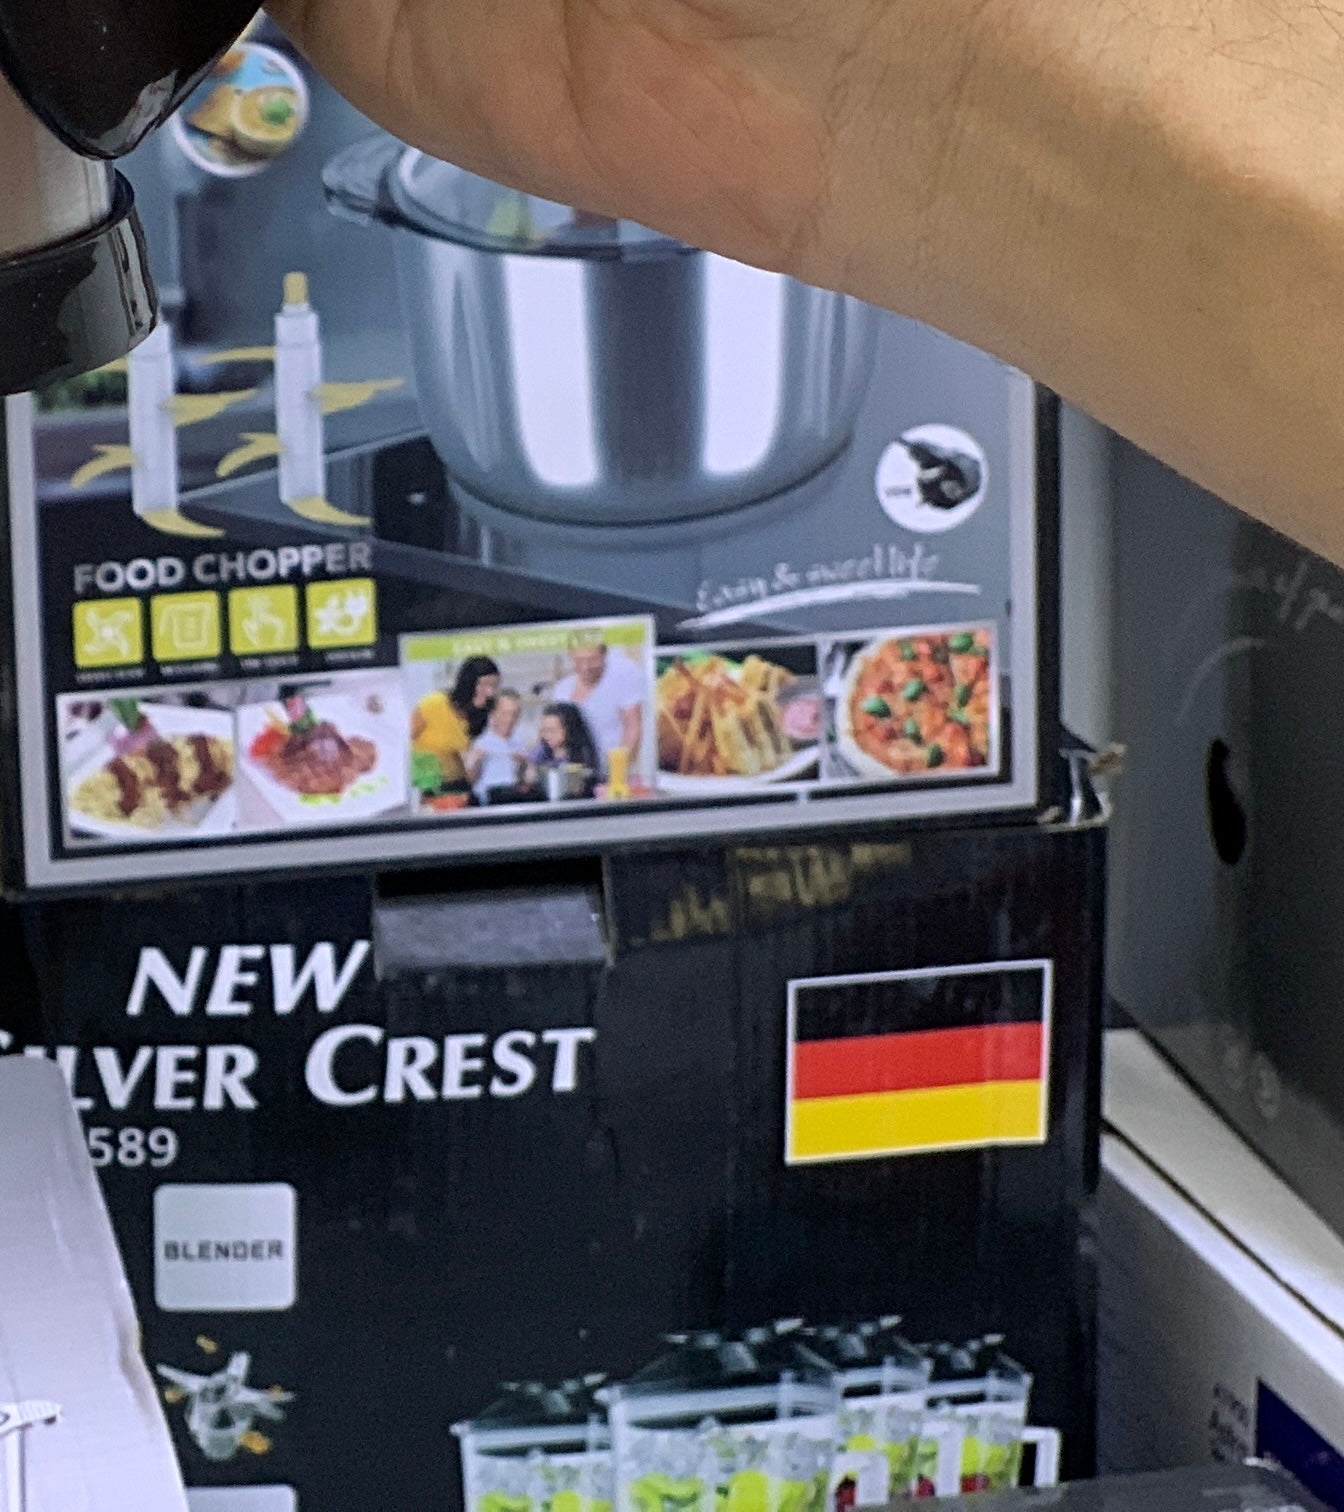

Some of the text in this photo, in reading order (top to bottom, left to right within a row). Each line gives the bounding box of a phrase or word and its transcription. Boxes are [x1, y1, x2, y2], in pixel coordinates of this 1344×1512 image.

[74, 543, 373, 593] FOOD CHOPPER
[126, 940, 372, 1017] NEW
[304, 1024, 597, 1107] CREST
[163, 1239, 285, 1262] BLENDER
